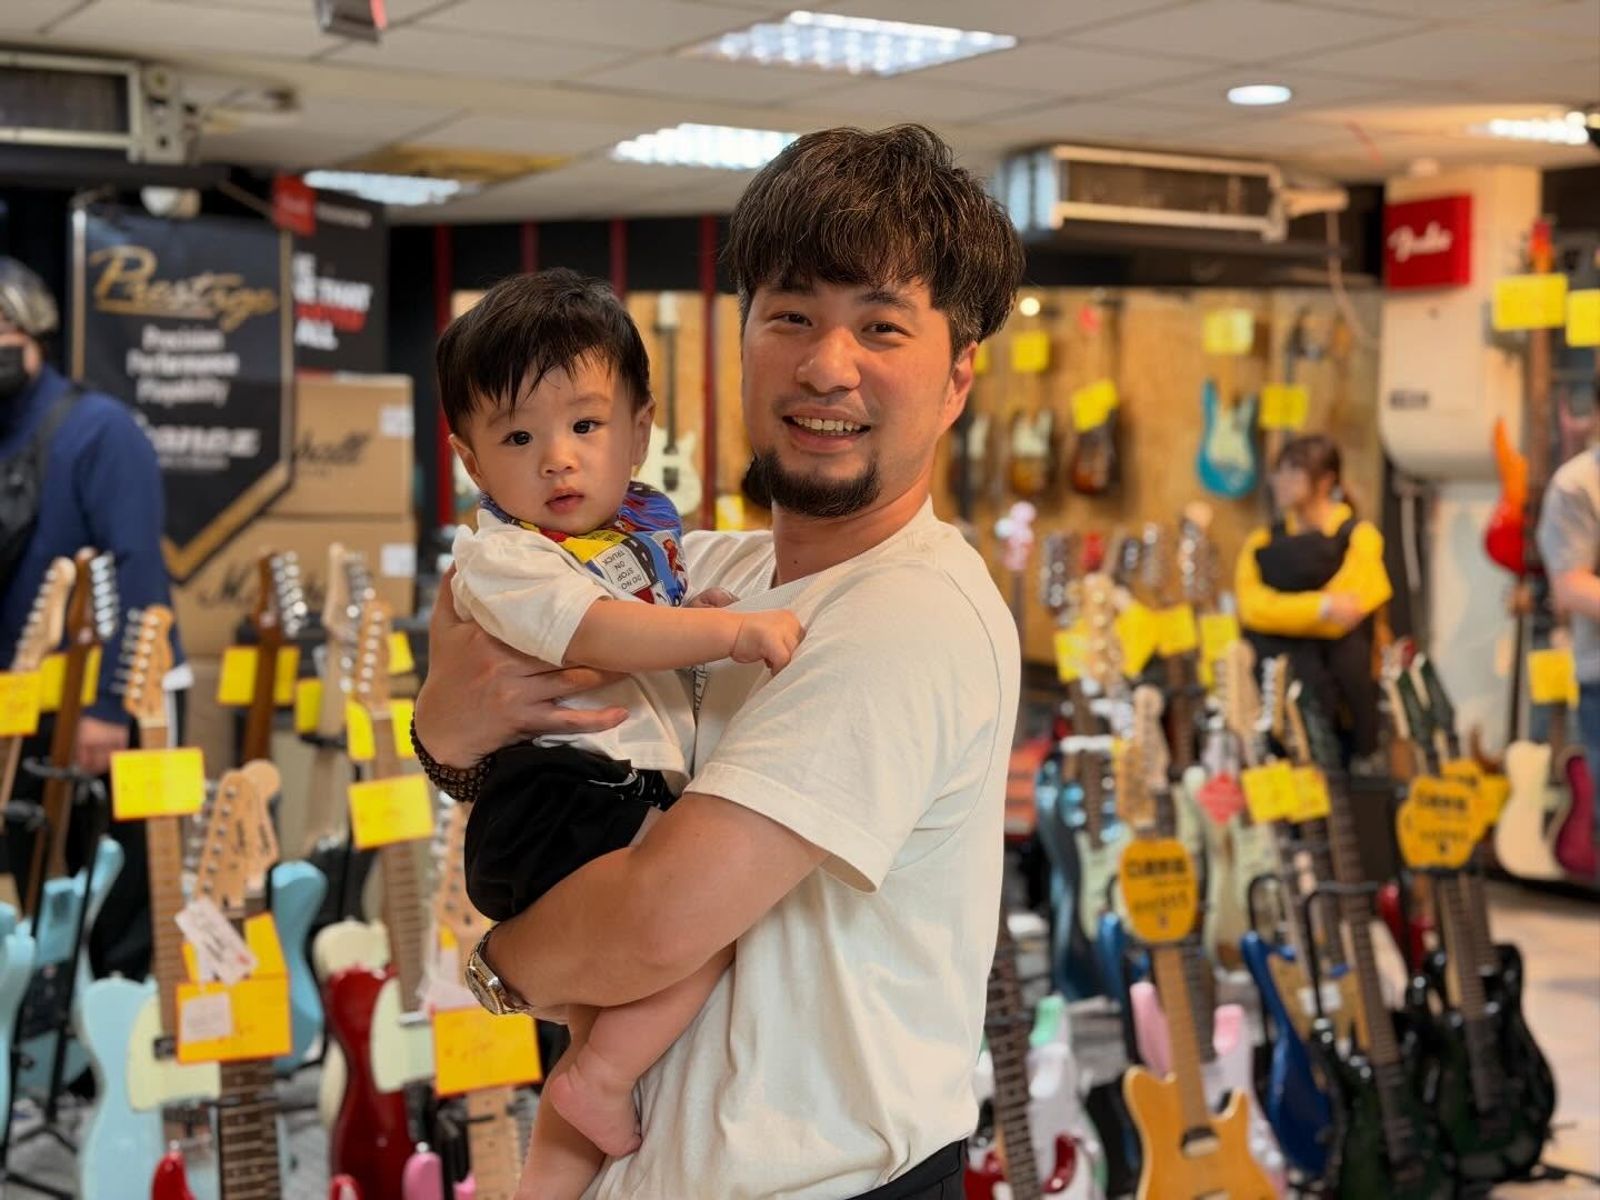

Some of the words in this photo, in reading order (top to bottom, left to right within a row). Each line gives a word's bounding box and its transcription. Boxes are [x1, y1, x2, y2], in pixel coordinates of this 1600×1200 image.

[90, 245, 278, 332] Prestige
[602, 550, 625, 566] TRUCK
[614, 560, 625, 570] ON
[617, 567, 633, 582] STOP
